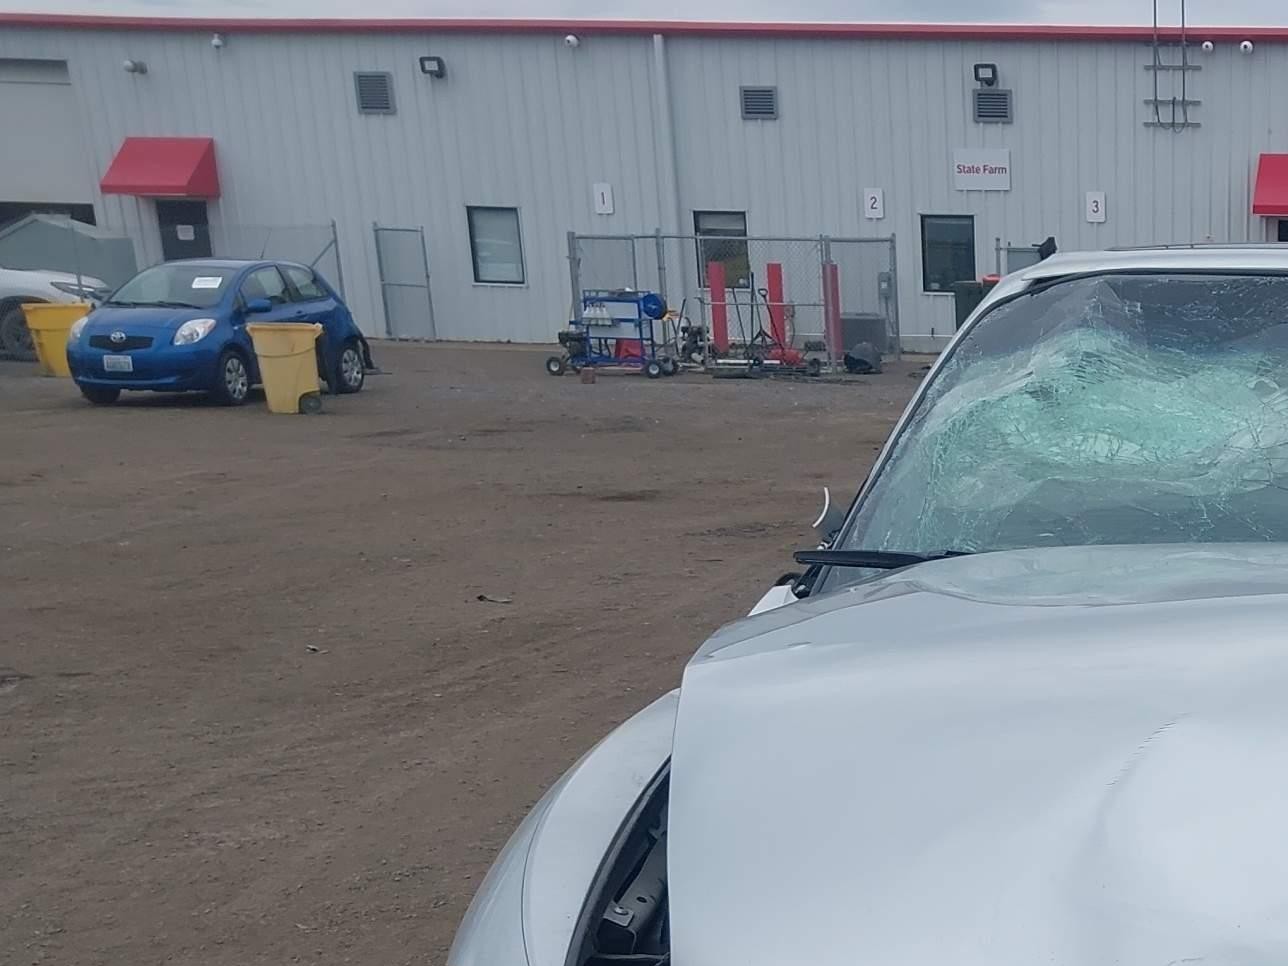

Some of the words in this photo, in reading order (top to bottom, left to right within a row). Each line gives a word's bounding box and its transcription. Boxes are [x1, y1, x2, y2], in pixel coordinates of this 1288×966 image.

[956, 164, 981, 174] State
[982, 164, 1007, 175] Farm
[870, 196, 878, 210] 2
[1091, 200, 1100, 213] 3
